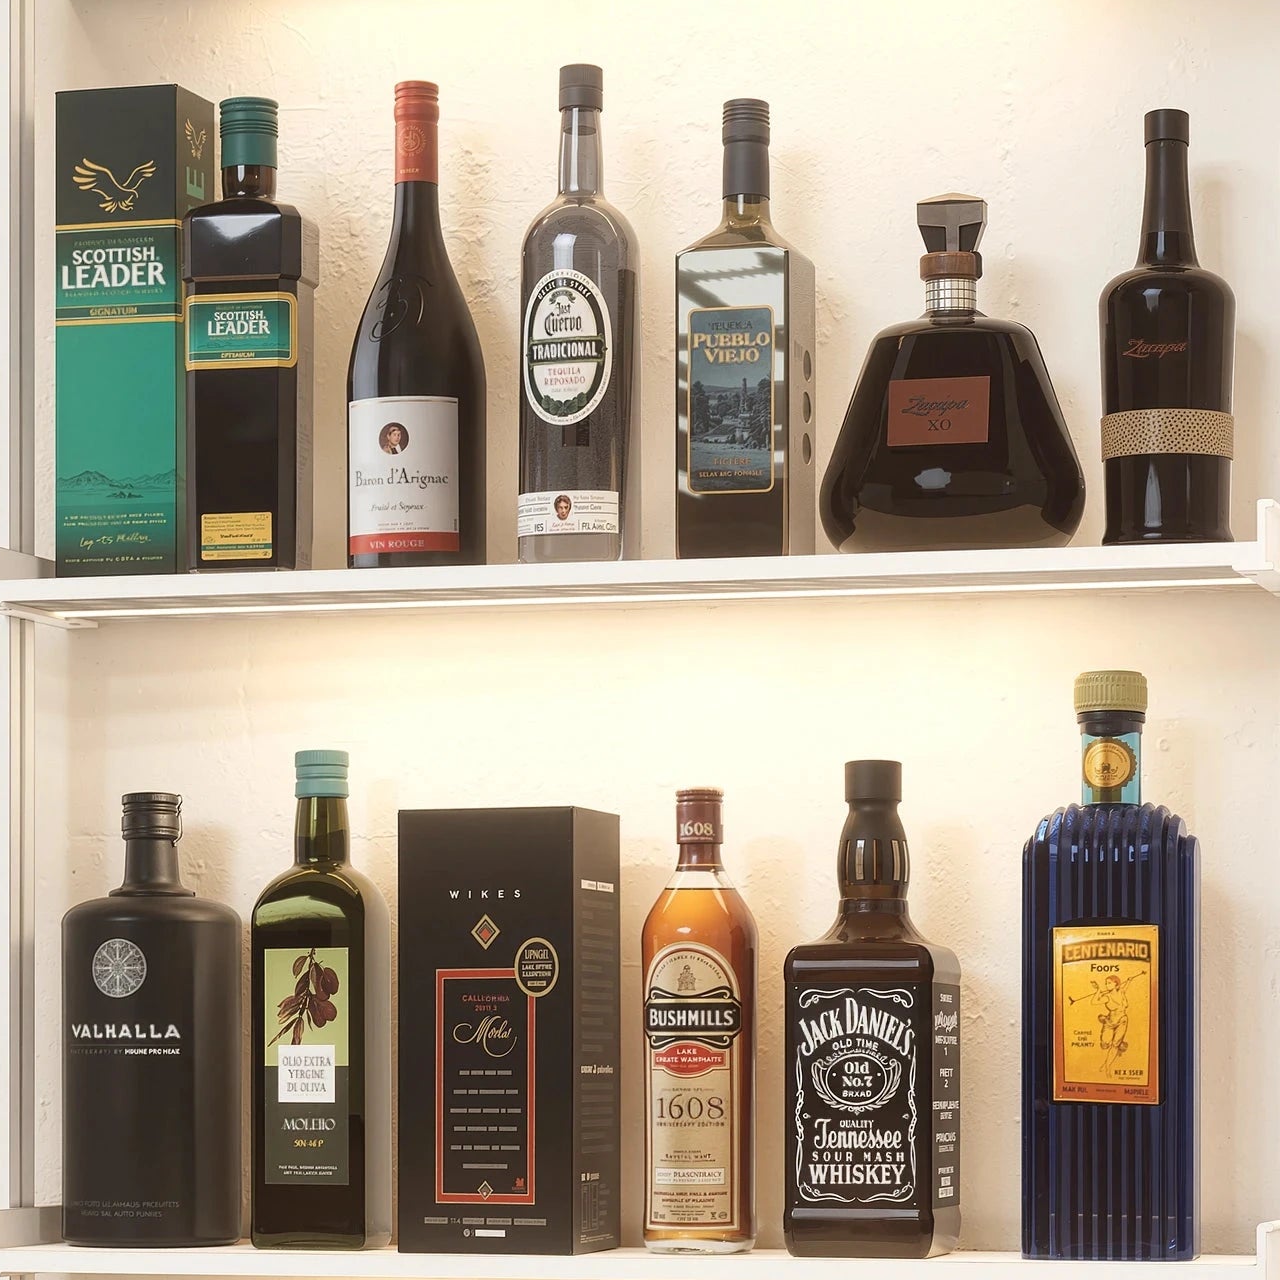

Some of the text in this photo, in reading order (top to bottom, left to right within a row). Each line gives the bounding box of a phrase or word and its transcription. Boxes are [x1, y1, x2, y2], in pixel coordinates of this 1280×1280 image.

[72, 246, 156, 265] SCOTTISH
[61, 262, 167, 290] LEADER
[214, 310, 266, 321] SCOTTISH
[207, 320, 271, 336] LEADER
[693, 331, 771, 348] PUEBLO
[532, 341, 598, 361] TRADICIONAL
[704, 347, 760, 364] VIEJO
[544, 376, 586, 386] REPOSADO
[927, 418, 952, 431] XO
[355, 467, 449, 489] Baron d'Arignac
[370, 539, 425, 550] VIN ROUGE
[680, 821, 714, 837] 1608
[449, 889, 522, 899] WIKES
[1064, 942, 1150, 960] CENTENARIO
[649, 1008, 734, 1026] BUSHMILLS
[71, 1023, 181, 1039] VALHALLA
[799, 1008, 844, 1056] JACK
[845, 997, 916, 1057] DANIEL'S
[832, 1038, 879, 1051] OLD TIME
[304, 1056, 331, 1066] EXTRA
[844, 1061, 870, 1074] Old
[841, 1075, 873, 1088] No.7
[656, 1093, 725, 1120] 1608
[839, 1120, 874, 1129] QUALITY
[814, 1118, 902, 1150] Tennessee
[812, 1151, 904, 1163] SOUR MASH
[808, 1163, 906, 1185] WHISKEY
